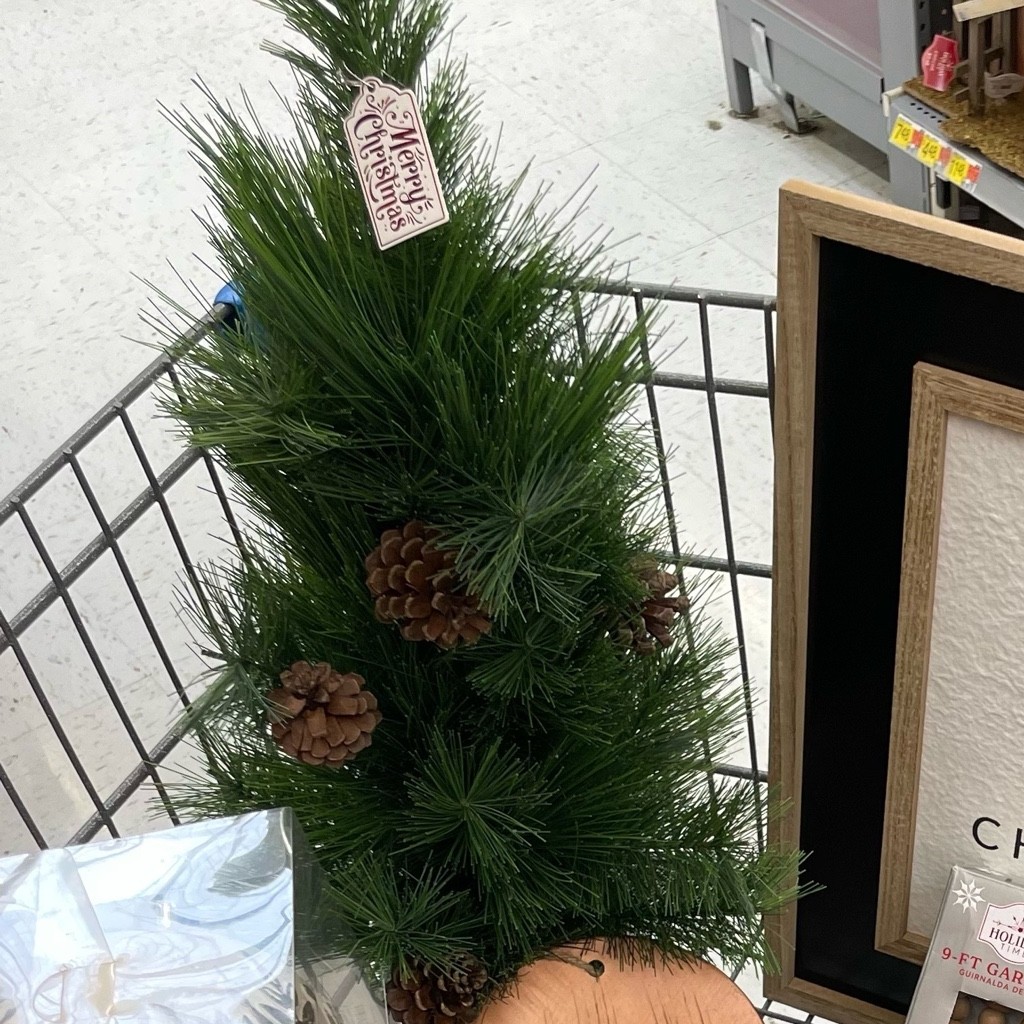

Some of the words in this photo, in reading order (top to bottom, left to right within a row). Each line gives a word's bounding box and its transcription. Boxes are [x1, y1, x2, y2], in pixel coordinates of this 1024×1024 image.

[354, 113, 407, 232] Christmas
[385, 111, 432, 214] Merry
[941, 947, 982, 970] 9-FT
[959, 969, 1011, 991] GUIRNALDA
[1012, 985, 1024, 995] DE
